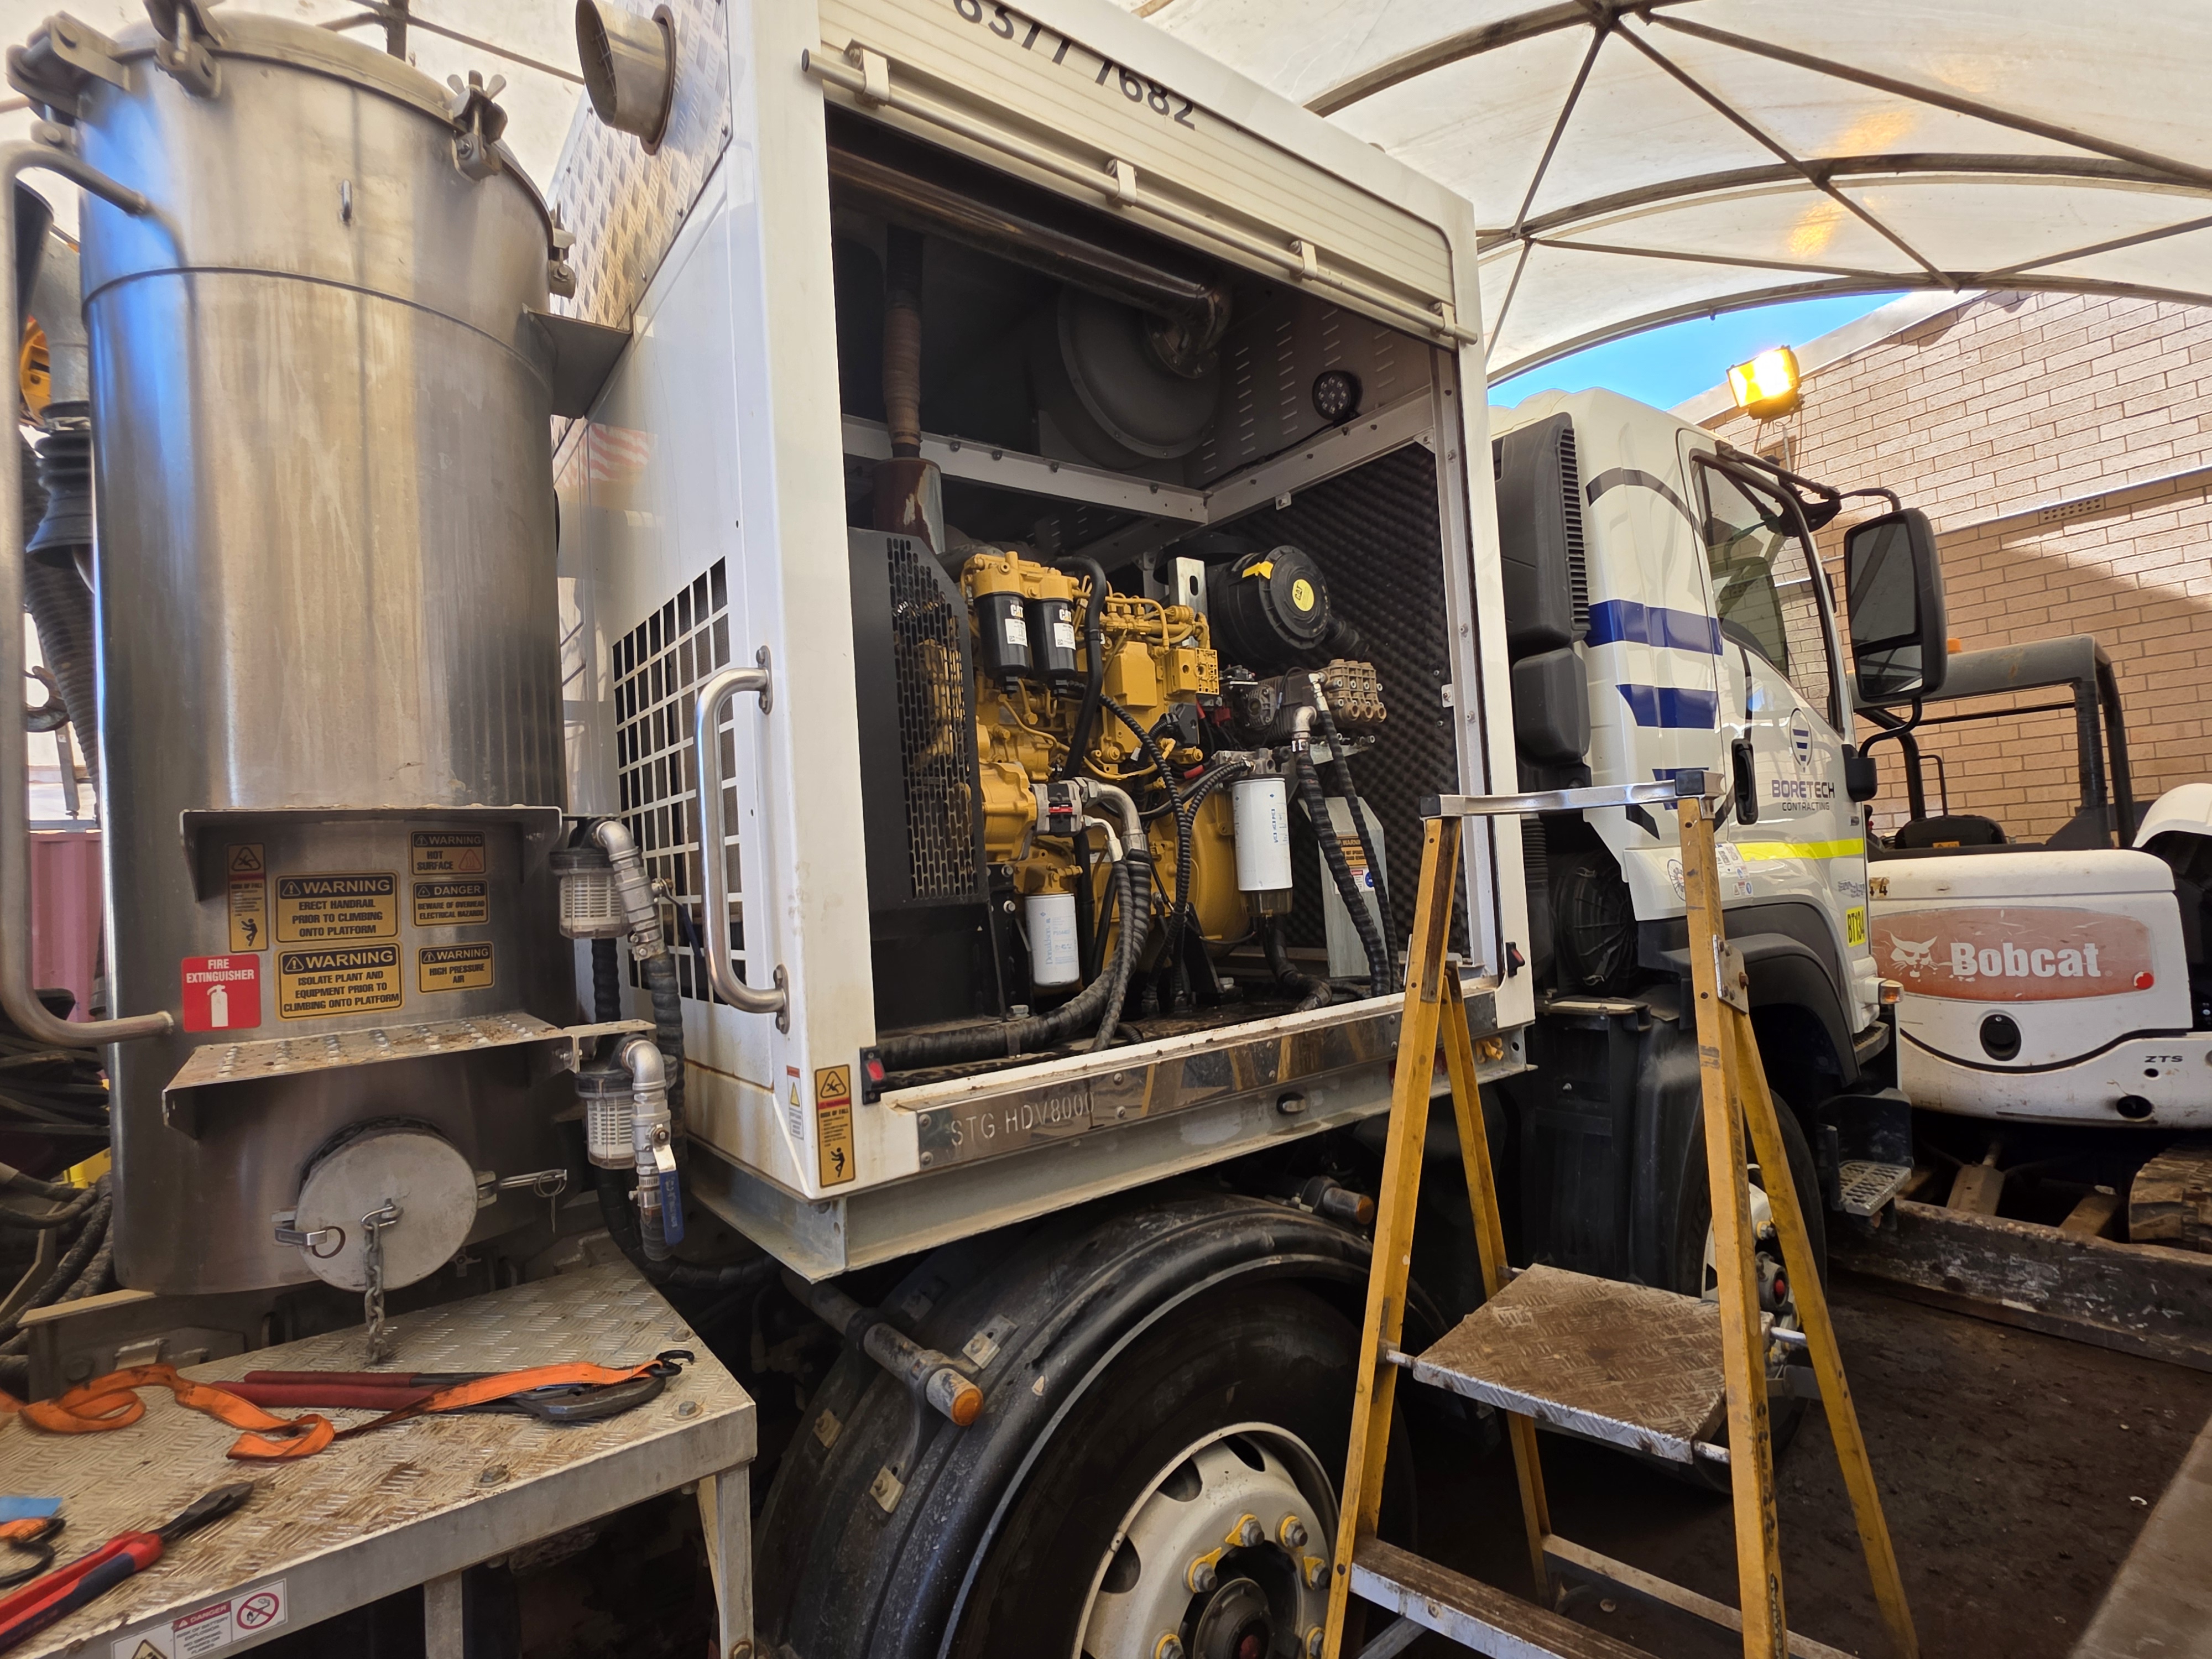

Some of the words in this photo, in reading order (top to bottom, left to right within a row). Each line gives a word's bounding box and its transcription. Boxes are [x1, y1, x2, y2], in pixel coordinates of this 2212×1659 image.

[1010, 604, 1024, 618] CAT
[1059, 609, 1072, 623] CAT
[1772, 780, 1835, 799] BORETECH
[1782, 802, 1830, 811] CONTRACTING
[429, 836, 481, 845] WARNING
[427, 851, 444, 859] HOT
[417, 861, 453, 870] SURFACE
[303, 879, 390, 894] WARNING
[434, 885, 481, 895] DANGER
[299, 900, 327, 911] ERECT
[330, 899, 376, 910] HANDRAIL
[418, 902, 444, 910] BEWARE
[446, 901, 454, 909] OF
[455, 900, 485, 909] OVERHEAD
[292, 915, 320, 924] PRIOR
[323, 914, 335, 923] TO
[338, 911, 383, 922] CLIMBING
[419, 911, 456, 920] ELECTRICAL
[299, 927, 324, 937] ONTO
[327, 925, 377, 936] PLATFORM
[1847, 910, 1865, 943] BT134
[306, 951, 394, 968] WARNING
[437, 948, 488, 961] WARNING
[1950, 942, 2101, 977] Bobcat
[207, 958, 230, 970] FIRE
[429, 967, 447, 977] HIGH
[450, 963, 485, 974] PRESSURE
[186, 969, 255, 984] EXTINGUISHER
[298, 975, 333, 986] ISOLATE
[335, 973, 363, 983] PLANT
[366, 971, 384, 980] AND
[452, 975, 465, 984] AIR
[295, 986, 346, 999] EQUIPMENT
[348, 984, 374, 994] PRIOR
[376, 982, 388, 991] TO
[283, 1000, 326, 1013] CLIMBING
[328, 998, 352, 1008] ONTO
[354, 993, 399, 1006] PLATFORM
[951, 1112, 995, 1146] STG
[1005, 1091, 1094, 1134] HDV8000
[190, 1605, 227, 1623] DANGER
[176, 1630, 191, 1639] RISK
[201, 1616, 229, 1629] BATTERY
[187, 1640, 210, 1651] SPARKS
